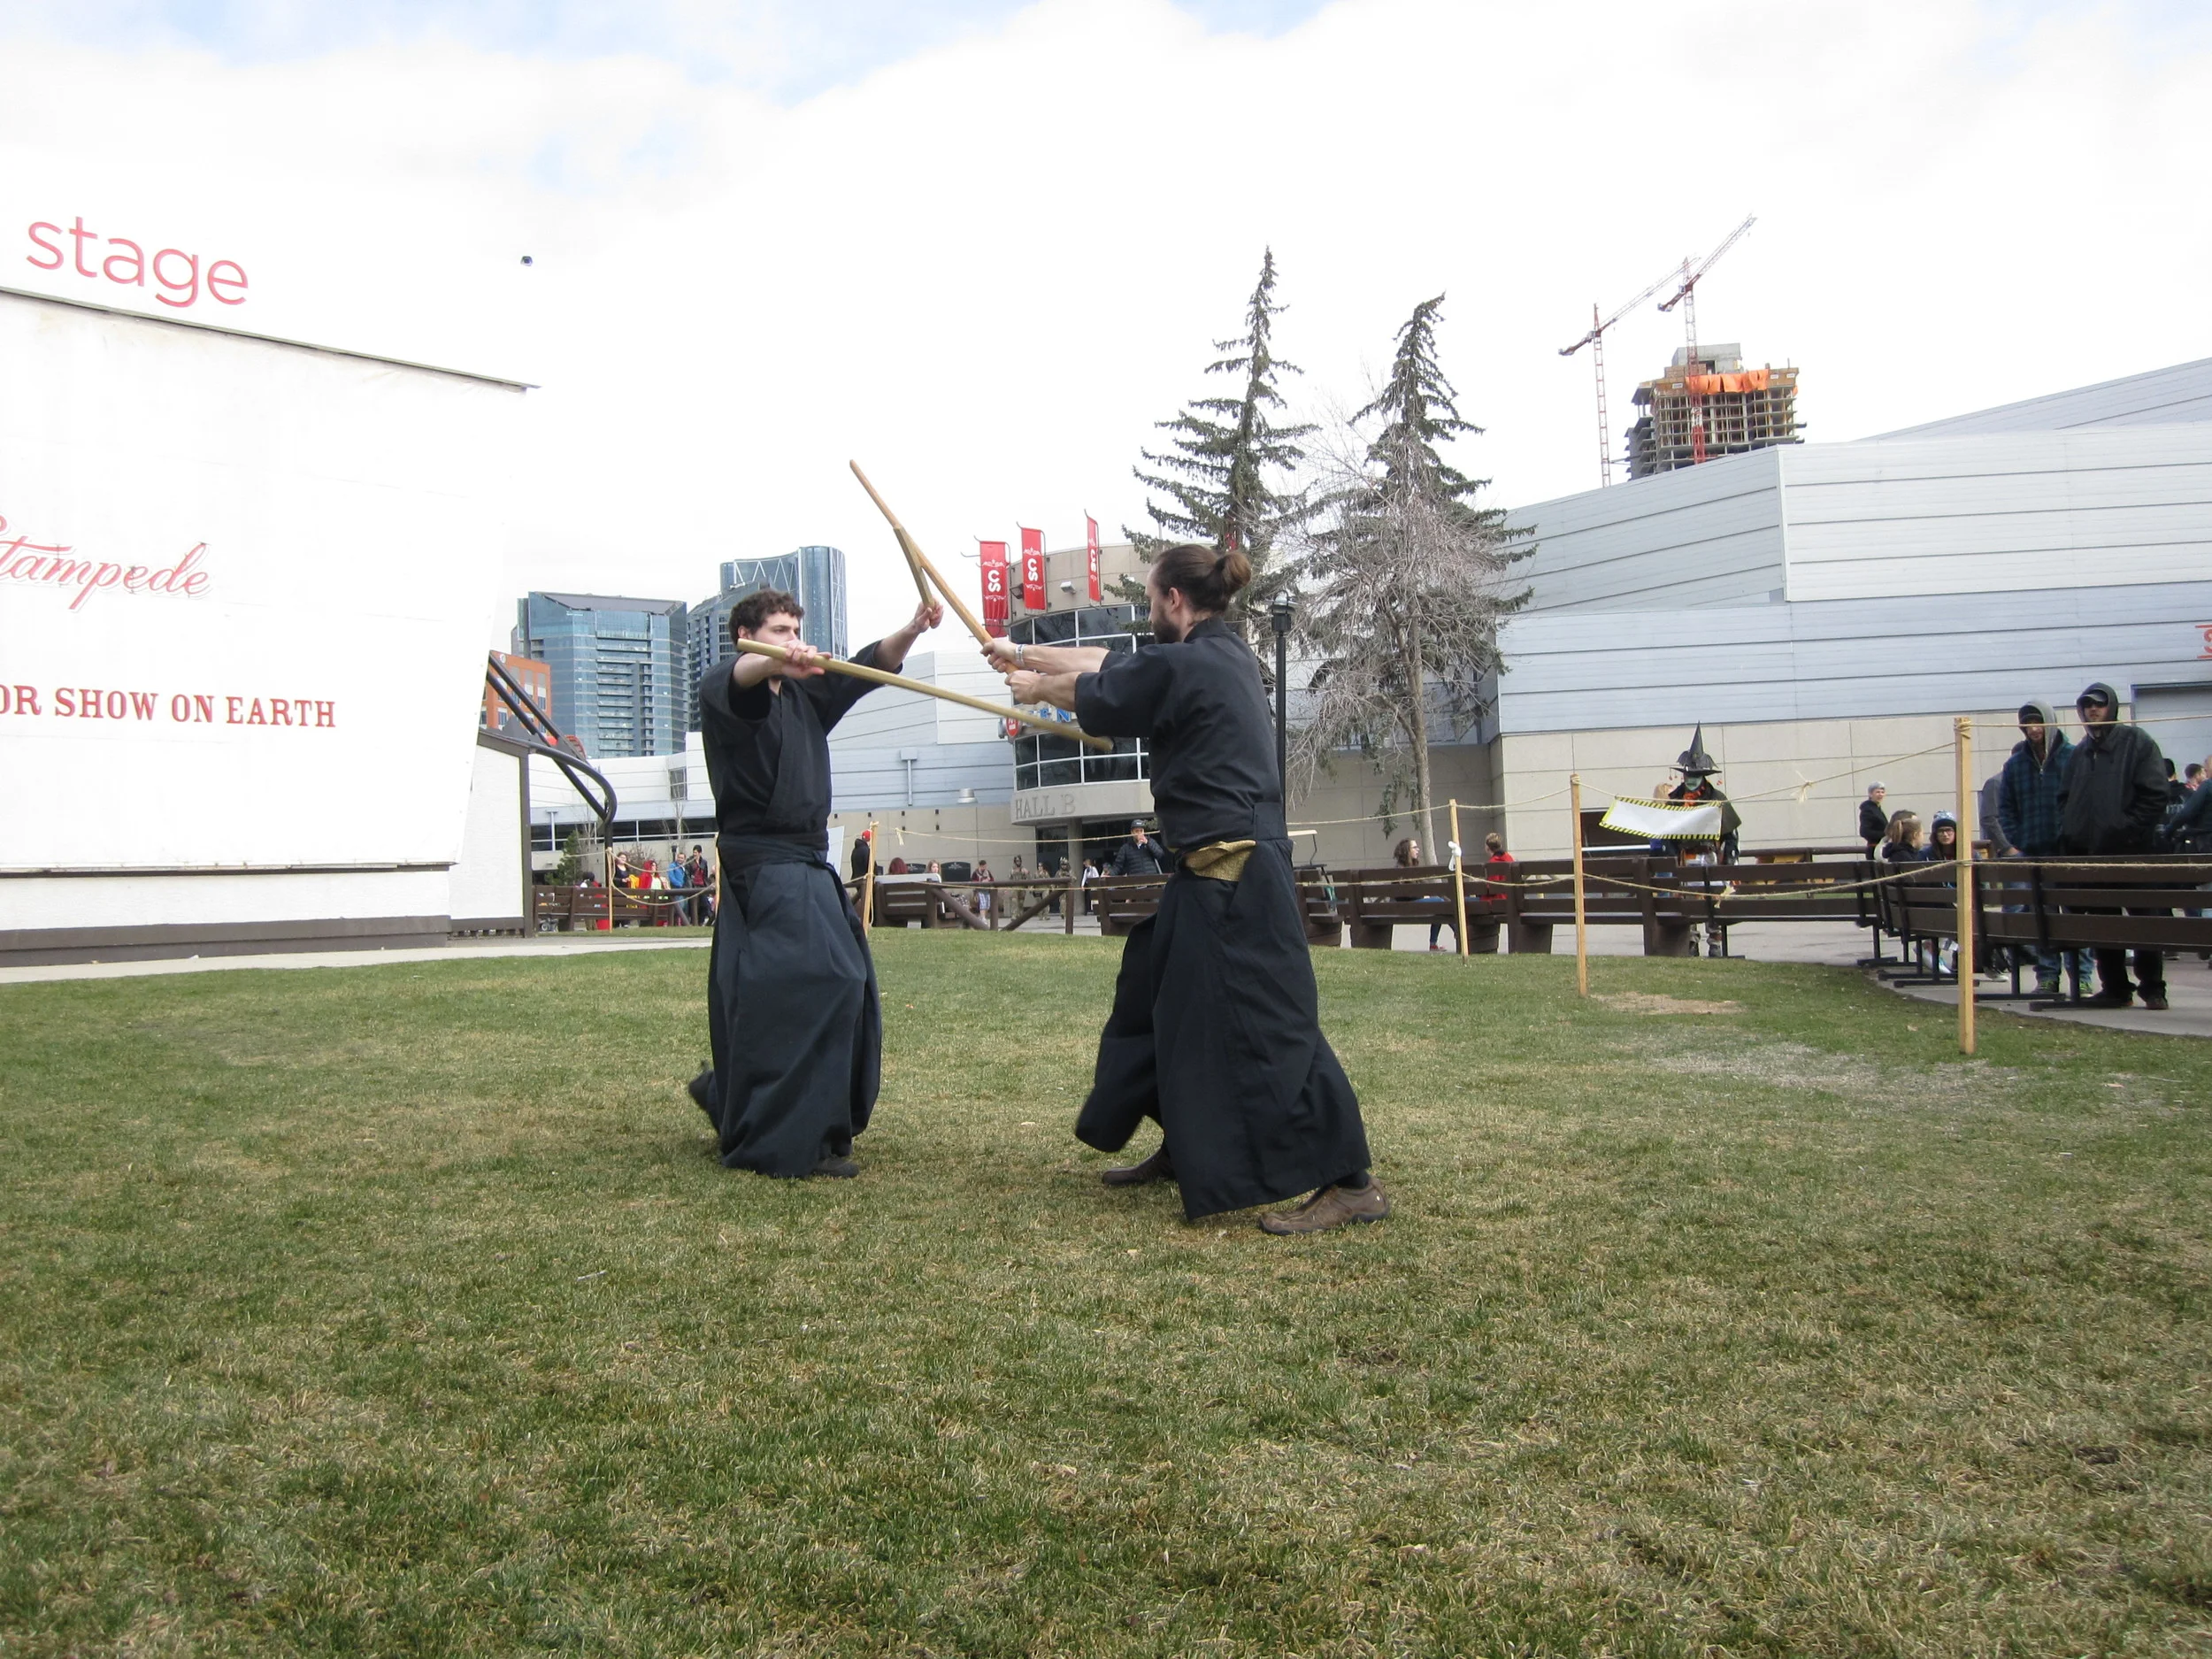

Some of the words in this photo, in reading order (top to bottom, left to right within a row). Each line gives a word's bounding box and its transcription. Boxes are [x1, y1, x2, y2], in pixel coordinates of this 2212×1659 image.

[27, 217, 249, 308] stage
[0, 515, 210, 610] tampede
[55, 687, 158, 720] SHOW
[172, 694, 214, 722] ON
[226, 696, 335, 727] EARTH
[1015, 795, 1056, 820] HALL
[1061, 794, 1076, 814] B
